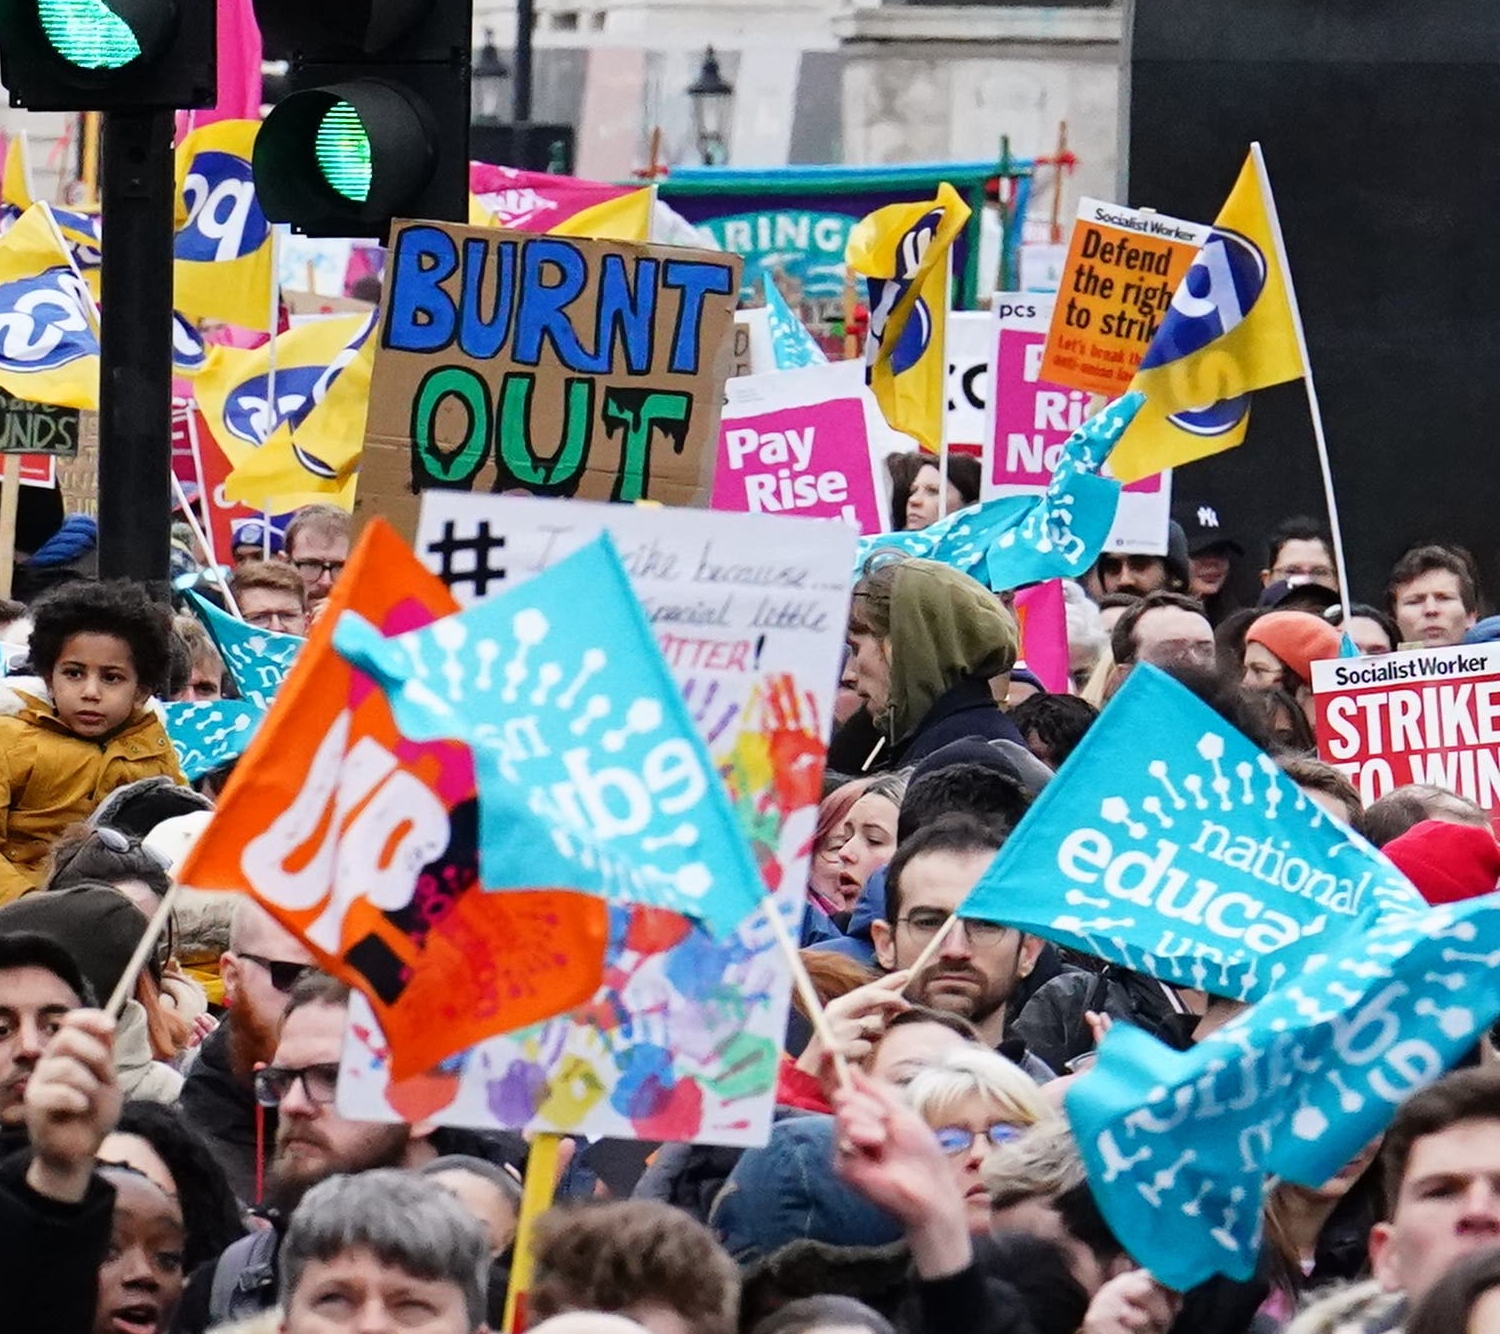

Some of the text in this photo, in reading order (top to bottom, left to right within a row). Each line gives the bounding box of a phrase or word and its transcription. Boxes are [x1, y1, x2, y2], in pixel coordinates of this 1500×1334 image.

[1094, 208, 1197, 242] Socialist Worker
[1081, 228, 1173, 277] Defend
[383, 223, 734, 377] BURNT
[1000, 302, 1037, 319] pcs
[1072, 265, 1174, 316] the righ
[1064, 297, 1092, 331] to
[1056, 333, 1126, 366] Let's break
[410, 364, 693, 503] OUT
[725, 427, 816, 472] Pay
[744, 468, 848, 514] Rise
[752, 596, 830, 633] little
[1335, 654, 1489, 687] Socialist Worker
[1326, 679, 1500, 761] STRIKE
[1190, 819, 1373, 917] national
